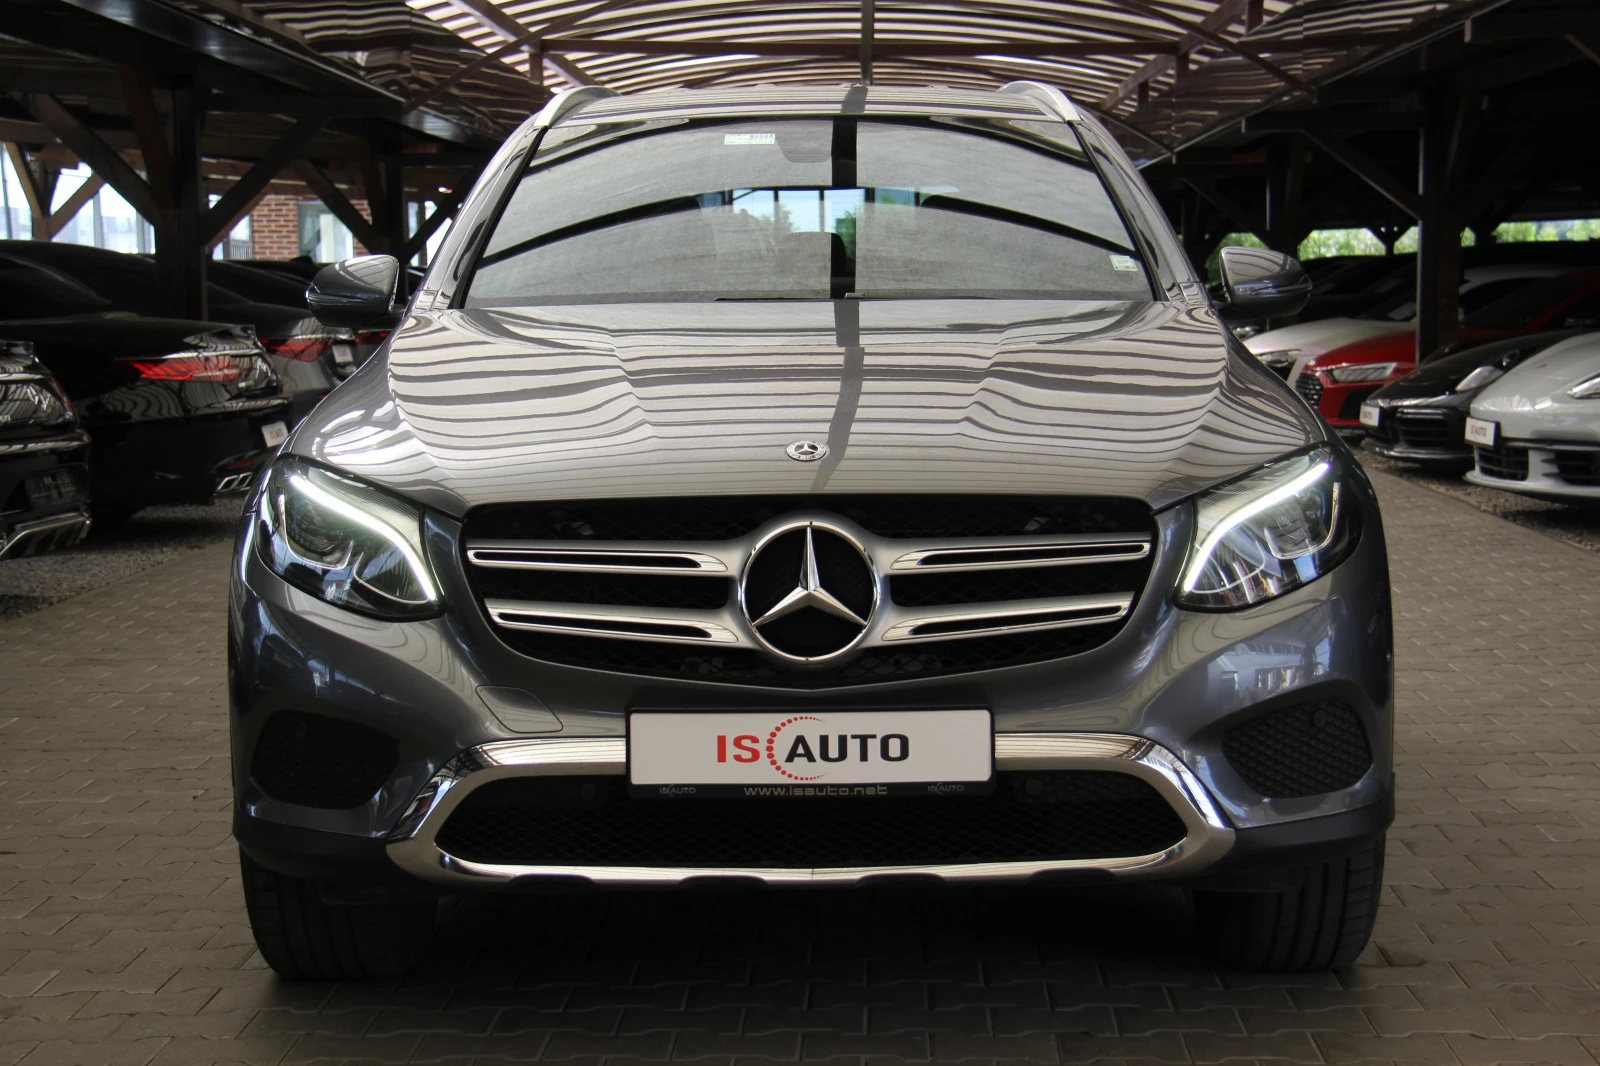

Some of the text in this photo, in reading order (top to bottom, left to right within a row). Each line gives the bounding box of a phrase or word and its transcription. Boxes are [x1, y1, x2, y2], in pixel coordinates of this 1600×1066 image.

[717, 734, 909, 763] IS AUTO
[743, 785, 888, 796] www.isauto.net
